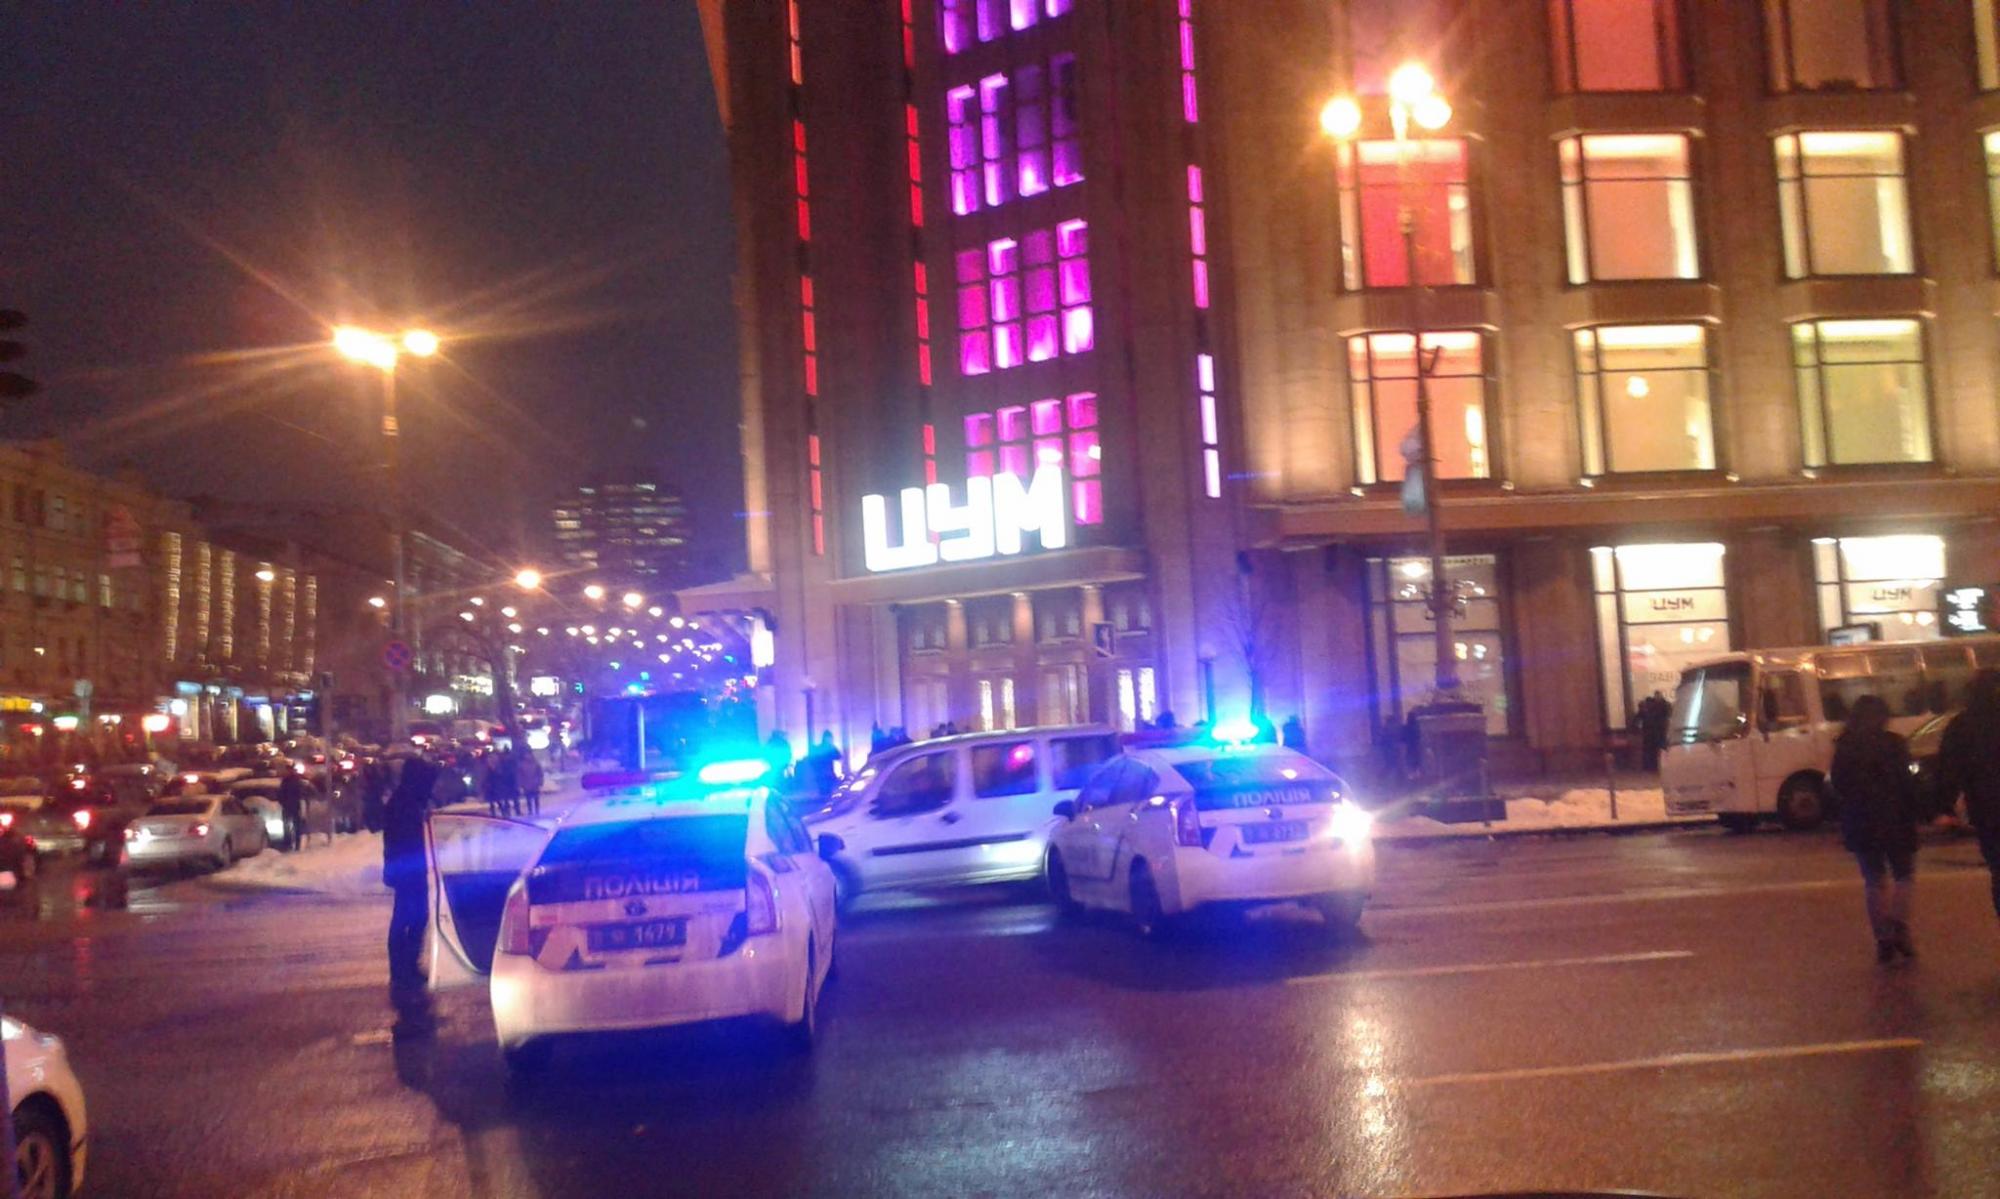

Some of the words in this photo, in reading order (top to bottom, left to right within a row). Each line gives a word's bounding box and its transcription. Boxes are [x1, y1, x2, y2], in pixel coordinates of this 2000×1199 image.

[862, 464, 1065, 572] ЦУМ
[1652, 597, 1695, 611] ЦУМ
[1233, 788, 1311, 808] ПОЛІЦІЯ
[585, 875, 699, 899] ПОЛІЦІЯ
